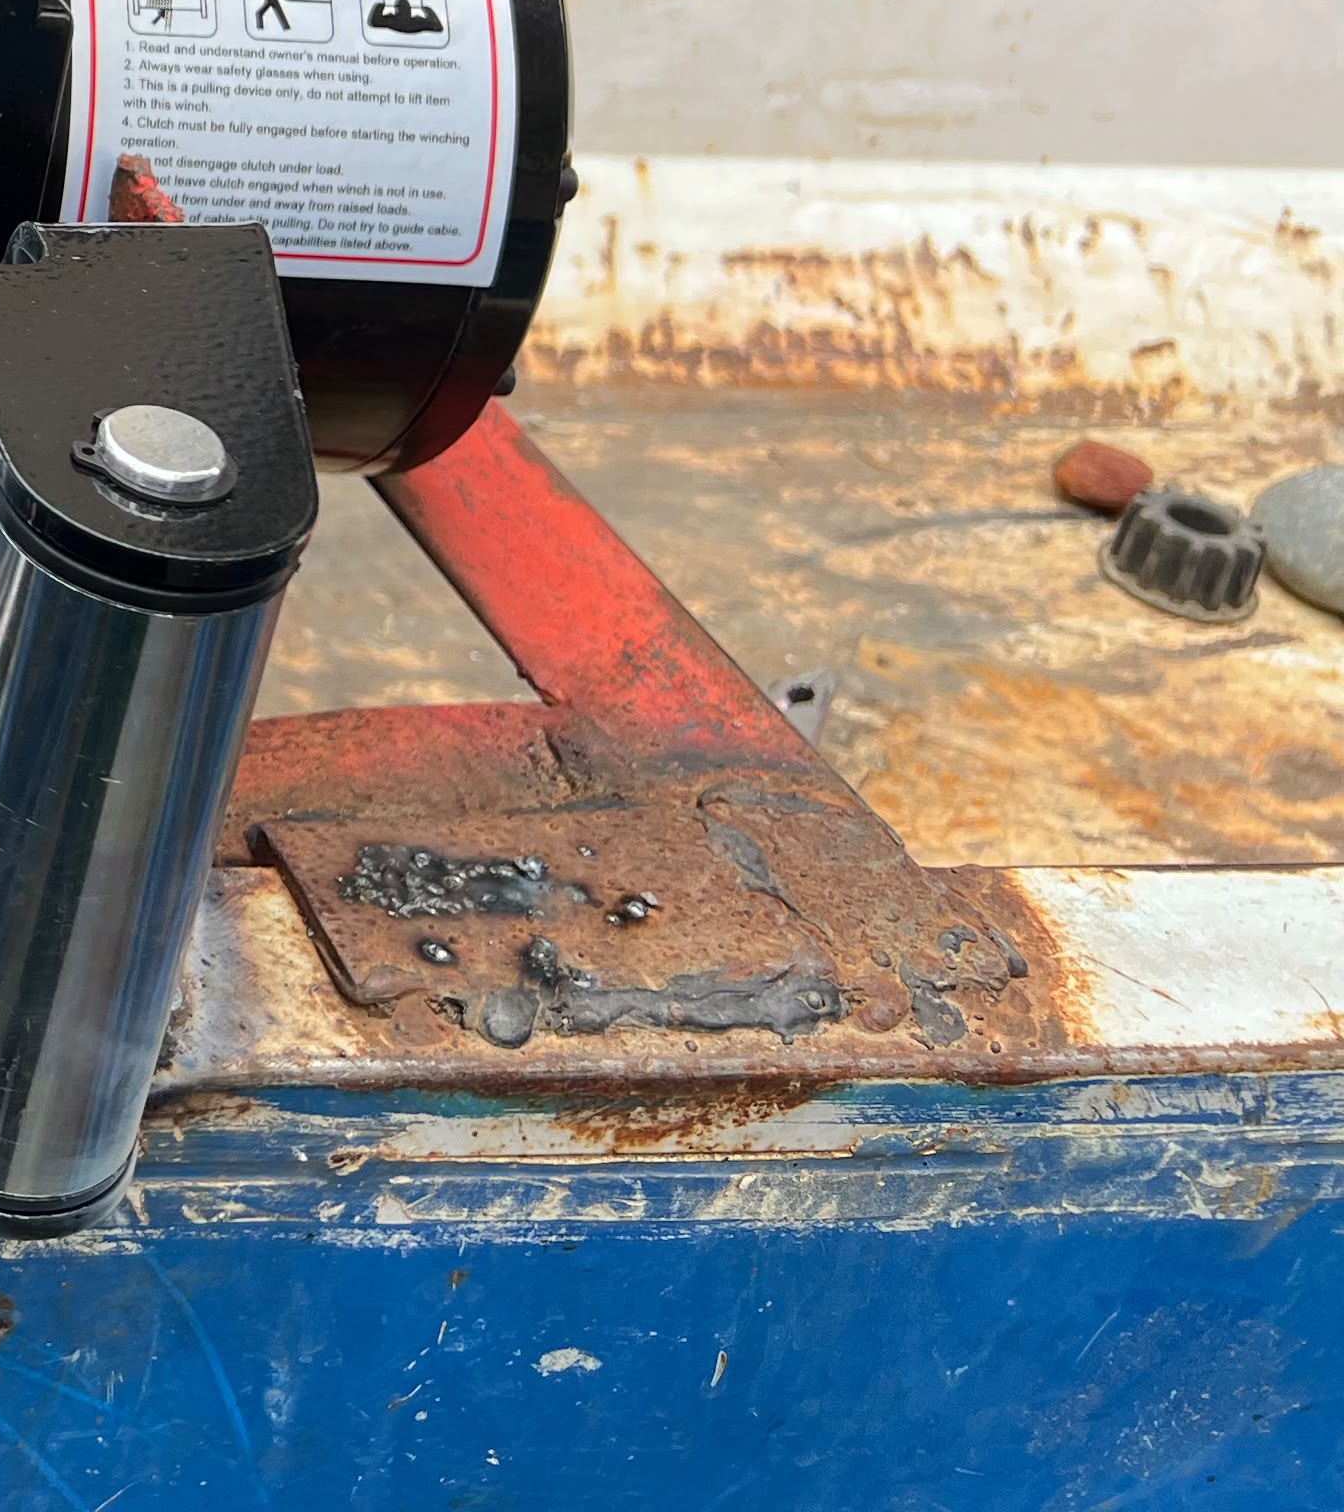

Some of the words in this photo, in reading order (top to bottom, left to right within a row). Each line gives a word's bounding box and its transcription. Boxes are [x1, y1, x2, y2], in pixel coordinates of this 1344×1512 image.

[139, 40, 171, 55] Read
[174, 43, 196, 56] and
[199, 44, 265, 59] understand
[317, 52, 360, 65] manual
[363, 53, 400, 67] before
[139, 60, 181, 75] Always
[184, 64, 213, 76] wear
[216, 64, 252, 79] safety
[255, 67, 300, 81] glasses
[303, 70, 335, 82] when
[123, 97, 147, 109] with
[150, 98, 171, 111] this
[139, 79, 164, 91] This
[168, 80, 177, 92] is
[180, 84, 189, 93] a
[191, 81, 230, 97] pulling
[233, 83, 272, 97] device
[307, 88, 322, 100] do
[325, 90, 344, 102] not
[347, 91, 391, 106] attempt
[394, 93, 405, 105] to
[408, 93, 422, 105] lift
[426, 94, 451, 107] item
[137, 116, 174, 130] Clutch
[177, 120, 207, 132] must
[210, 121, 225, 133] be
[229, 122, 252, 137] fully
[256, 124, 307, 139] engaged
[310, 125, 348, 139] before
[351, 128, 395, 144] starting
[398, 130, 416, 143] the
[419, 132, 471, 148] winching
[154, 155, 173, 167] not
[176, 155, 238, 172] disengage
[241, 159, 276, 173] clutch
[279, 161, 313, 175] under
[174, 174, 206, 187] leave
[209, 175, 245, 189] clutch
[248, 178, 299, 194] engaged
[302, 182, 333, 194] when
[336, 183, 371, 196] winch
[373, 185, 384, 197] is
[386, 187, 405, 198] not
[408, 187, 419, 199] in
[181, 192, 208, 206] from
[211, 194, 245, 207] under
[249, 196, 271, 209] and
[274, 199, 305, 213] away
[308, 198, 335, 212] from
[337, 200, 373, 214] raised
[188, 211, 202, 223] of
[317, 218, 334, 231] Do
[337, 220, 357, 232] not
[359, 220, 375, 235] try
[378, 221, 389, 233] to
[392, 222, 424, 239] guide
[272, 234, 337, 249] capabilities
[340, 237, 371, 250] listed
